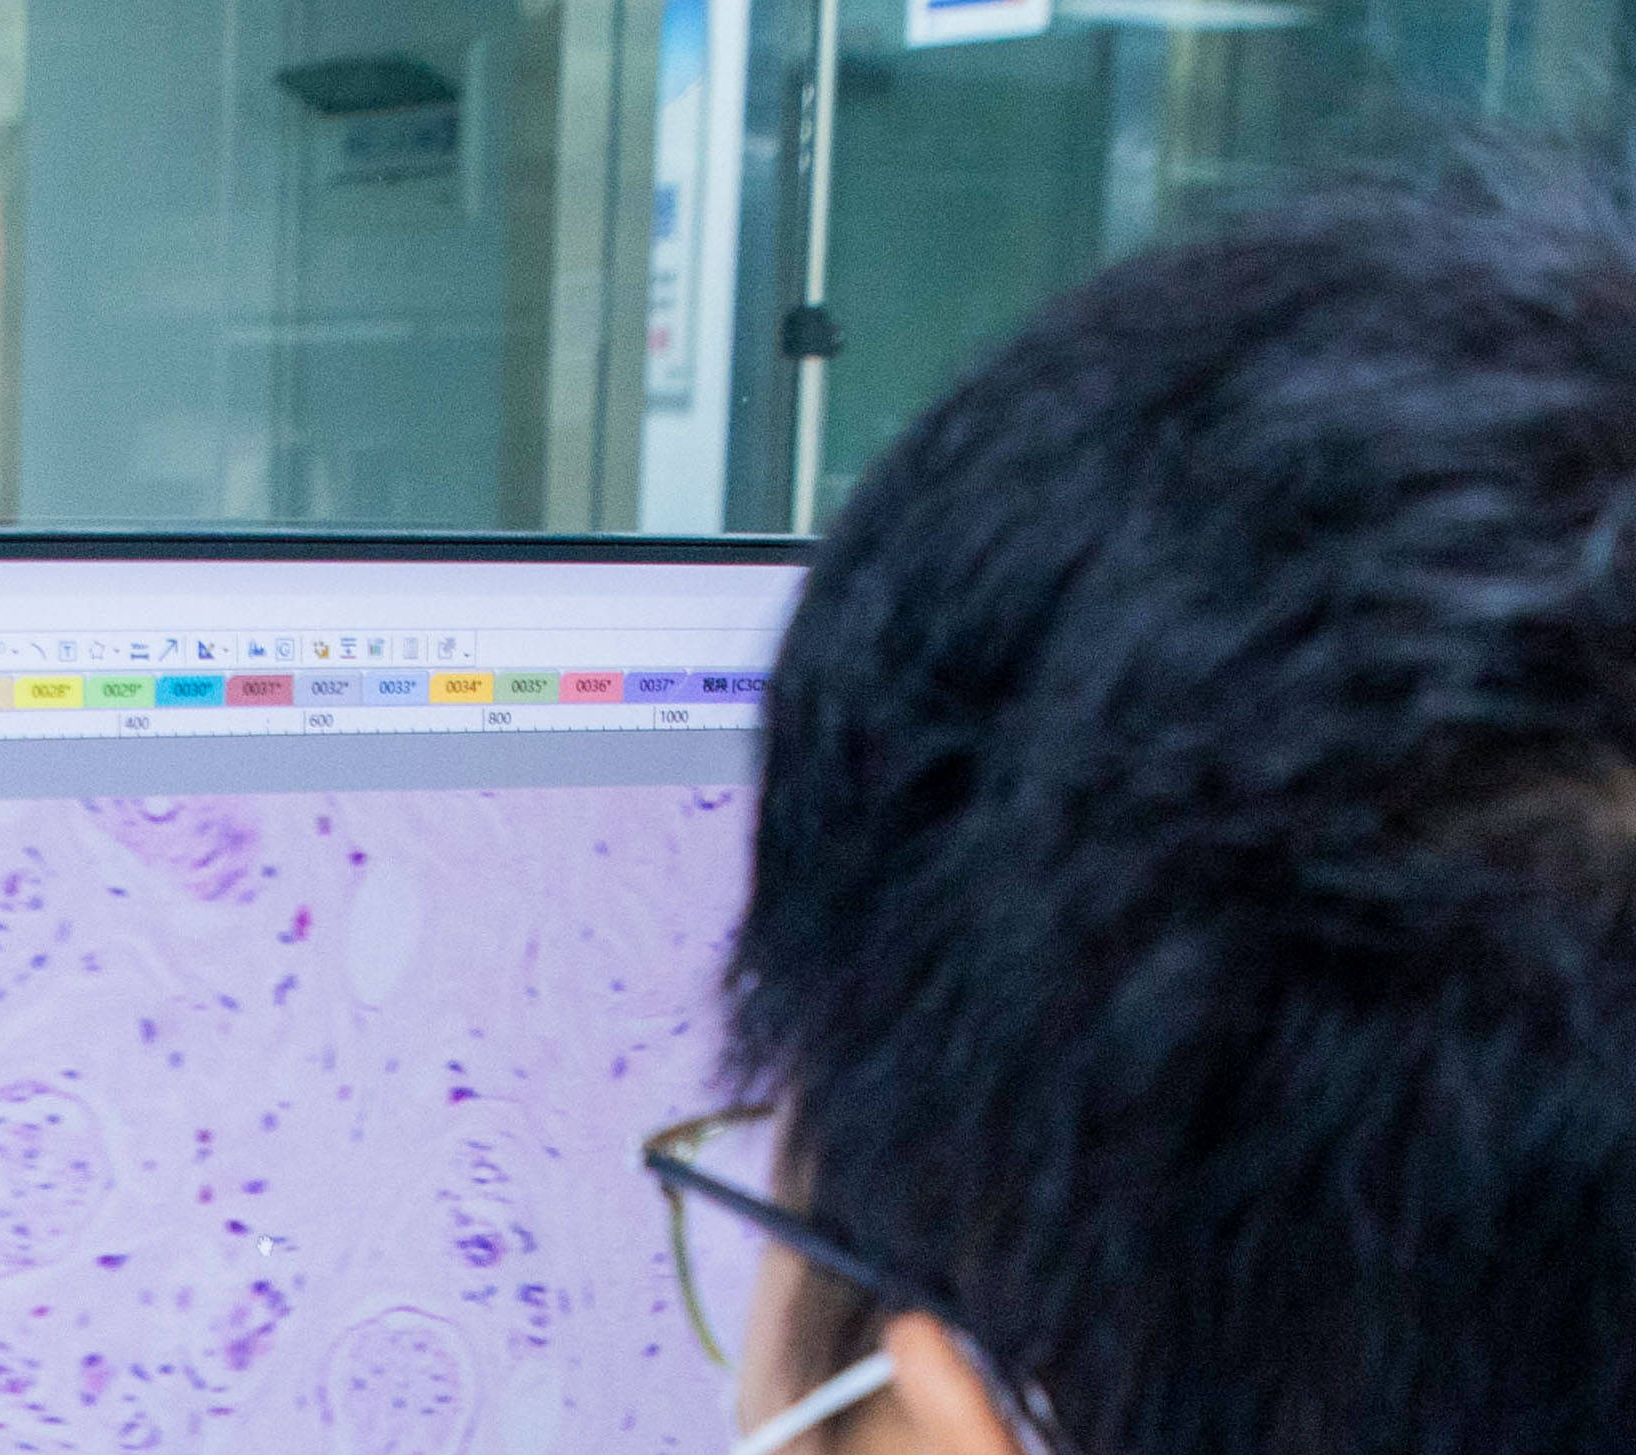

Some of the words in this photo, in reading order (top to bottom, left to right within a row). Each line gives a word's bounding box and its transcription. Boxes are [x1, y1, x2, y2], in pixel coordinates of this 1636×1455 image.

[125, 717, 149, 730] 400
[309, 715, 333, 727] 600
[489, 712, 511, 724] 800
[661, 711, 688, 723] 1000
